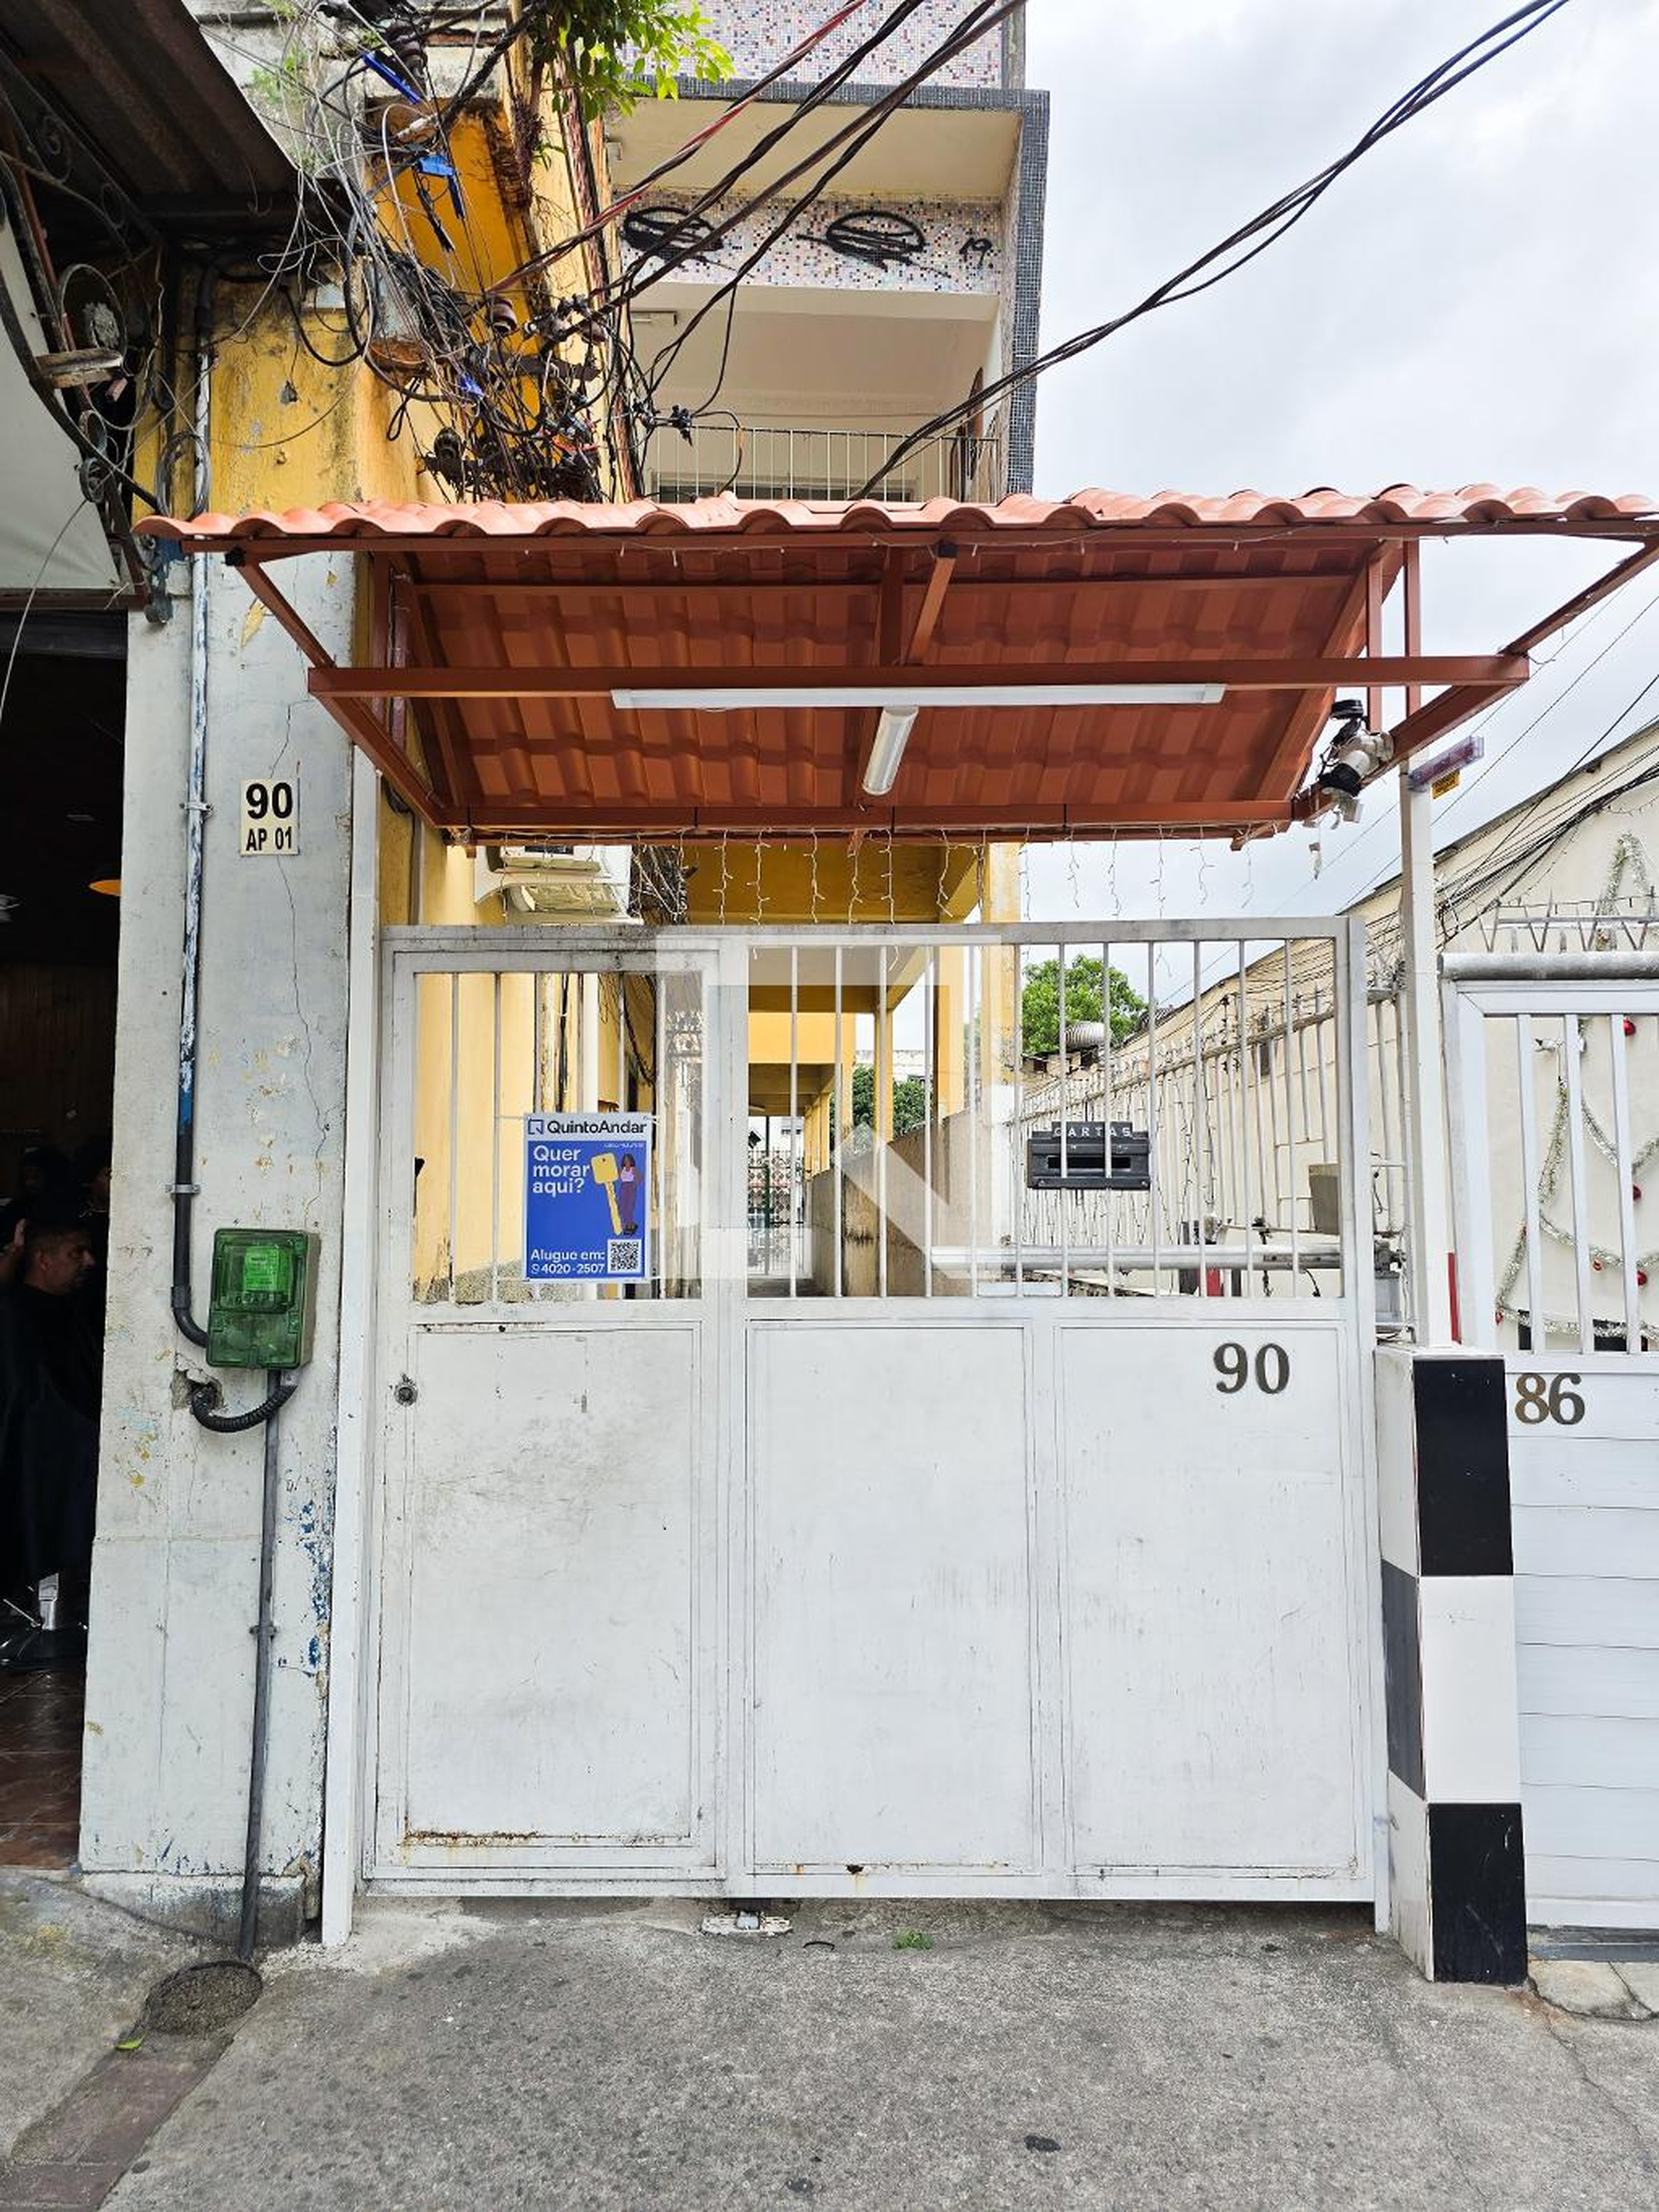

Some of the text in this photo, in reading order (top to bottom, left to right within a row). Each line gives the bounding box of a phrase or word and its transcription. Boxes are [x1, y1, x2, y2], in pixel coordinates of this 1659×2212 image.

[246, 783, 292, 819] 90
[246, 826, 292, 851] AP 01
[547, 1120, 647, 1134] QuintoAndar
[1054, 1127, 1131, 1136] CARTAS
[533, 1145, 581, 1162] Quer
[533, 1165, 590, 1177] morar
[533, 1178, 585, 1197] aqui?
[531, 1249, 605, 1263] Alugue em:
[1214, 1343, 1290, 1394] 90
[1515, 1372, 1585, 1425] 86
